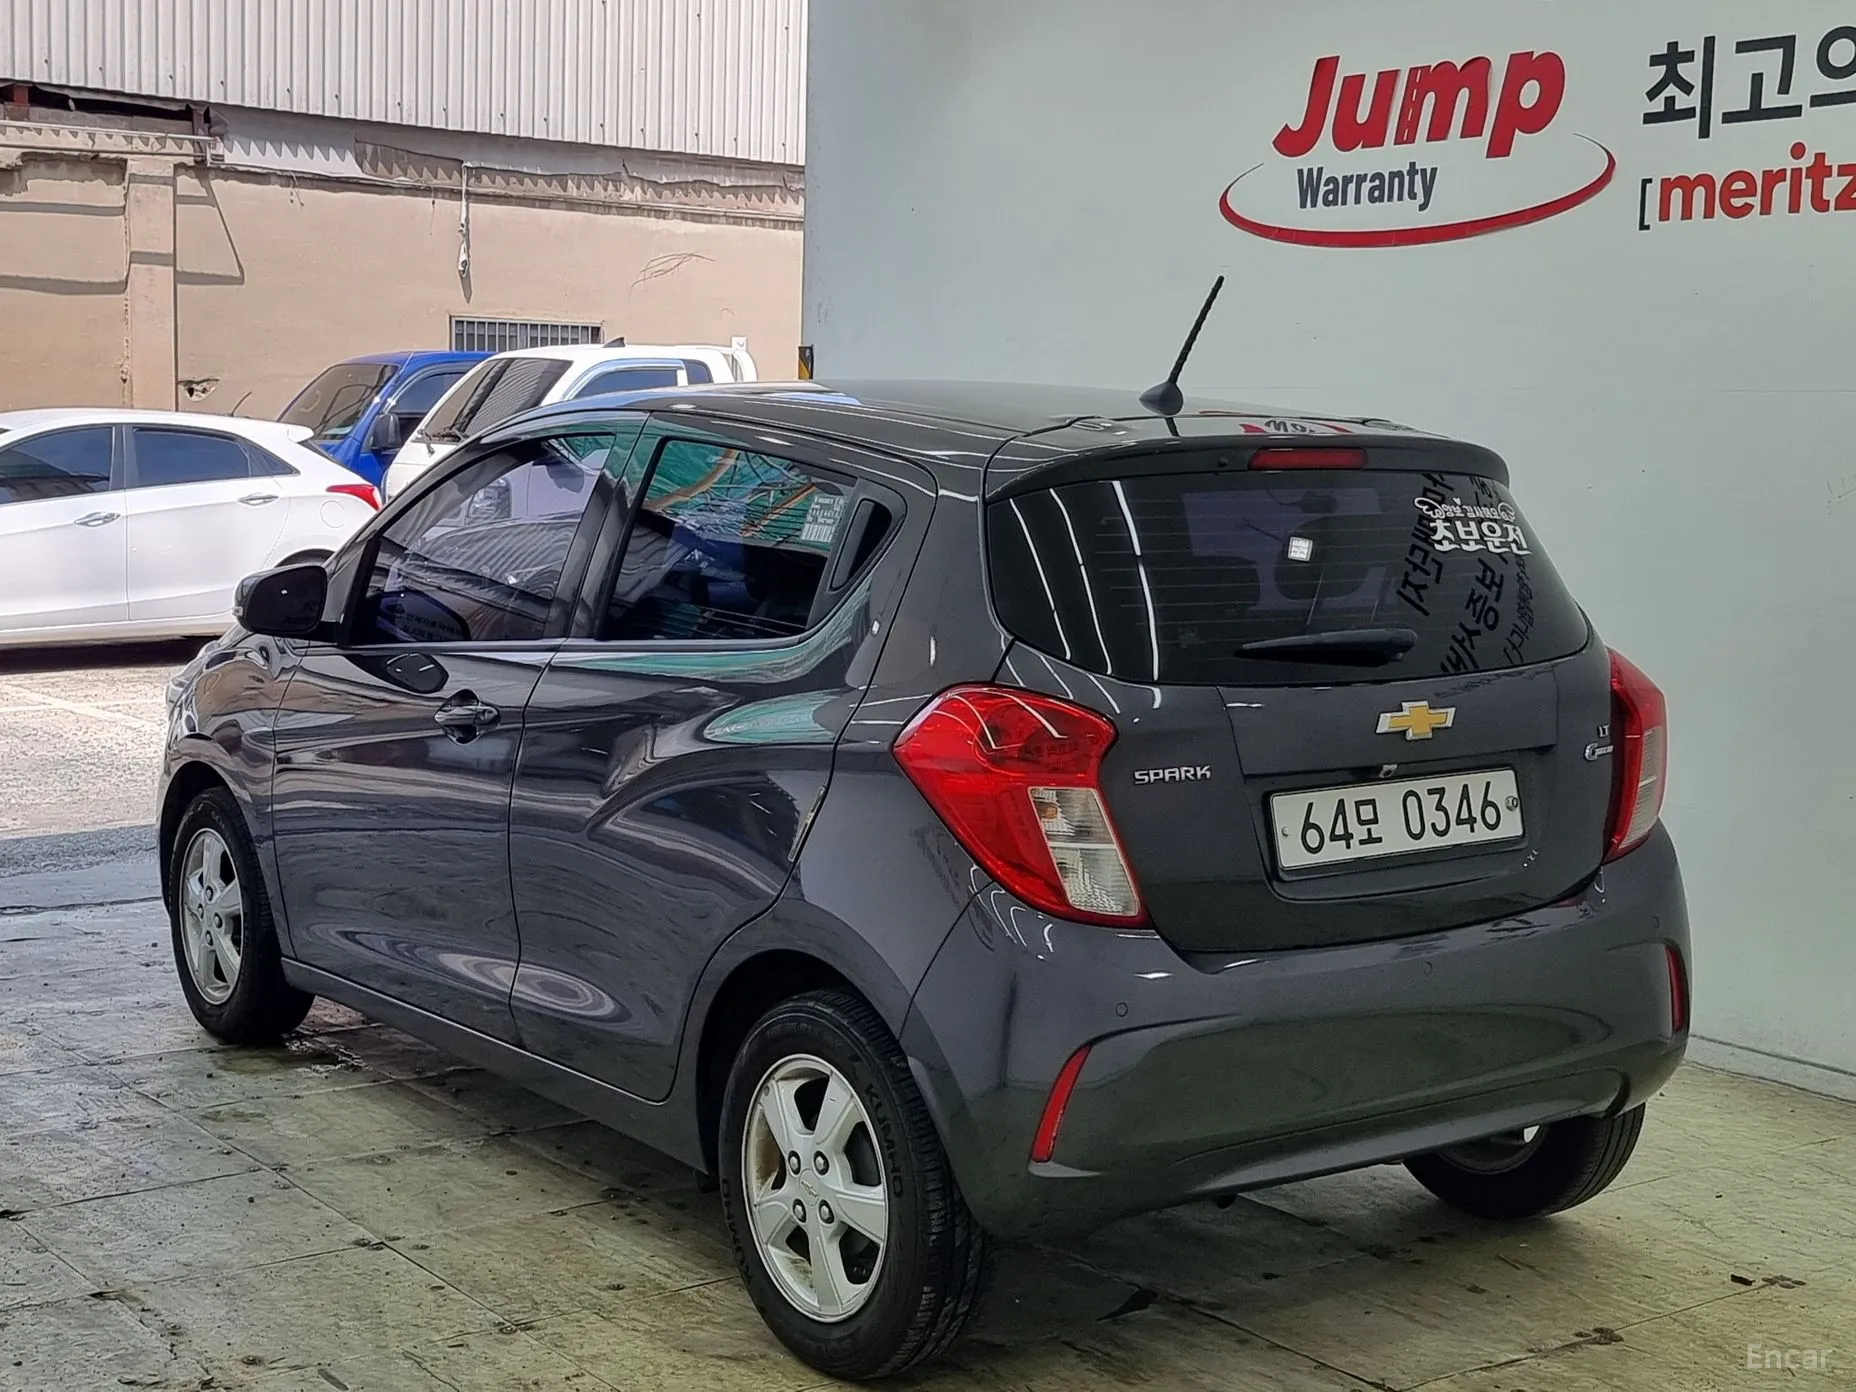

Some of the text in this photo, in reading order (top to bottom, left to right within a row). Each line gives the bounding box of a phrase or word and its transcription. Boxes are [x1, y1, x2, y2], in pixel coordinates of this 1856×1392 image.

[1272, 51, 1566, 158] Jump
[1296, 161, 1438, 212] Warranty
[1429, 519, 1532, 555] 초보운전
[1134, 764, 1212, 785] SPARK
[1301, 781, 1501, 854] 64모 0346
